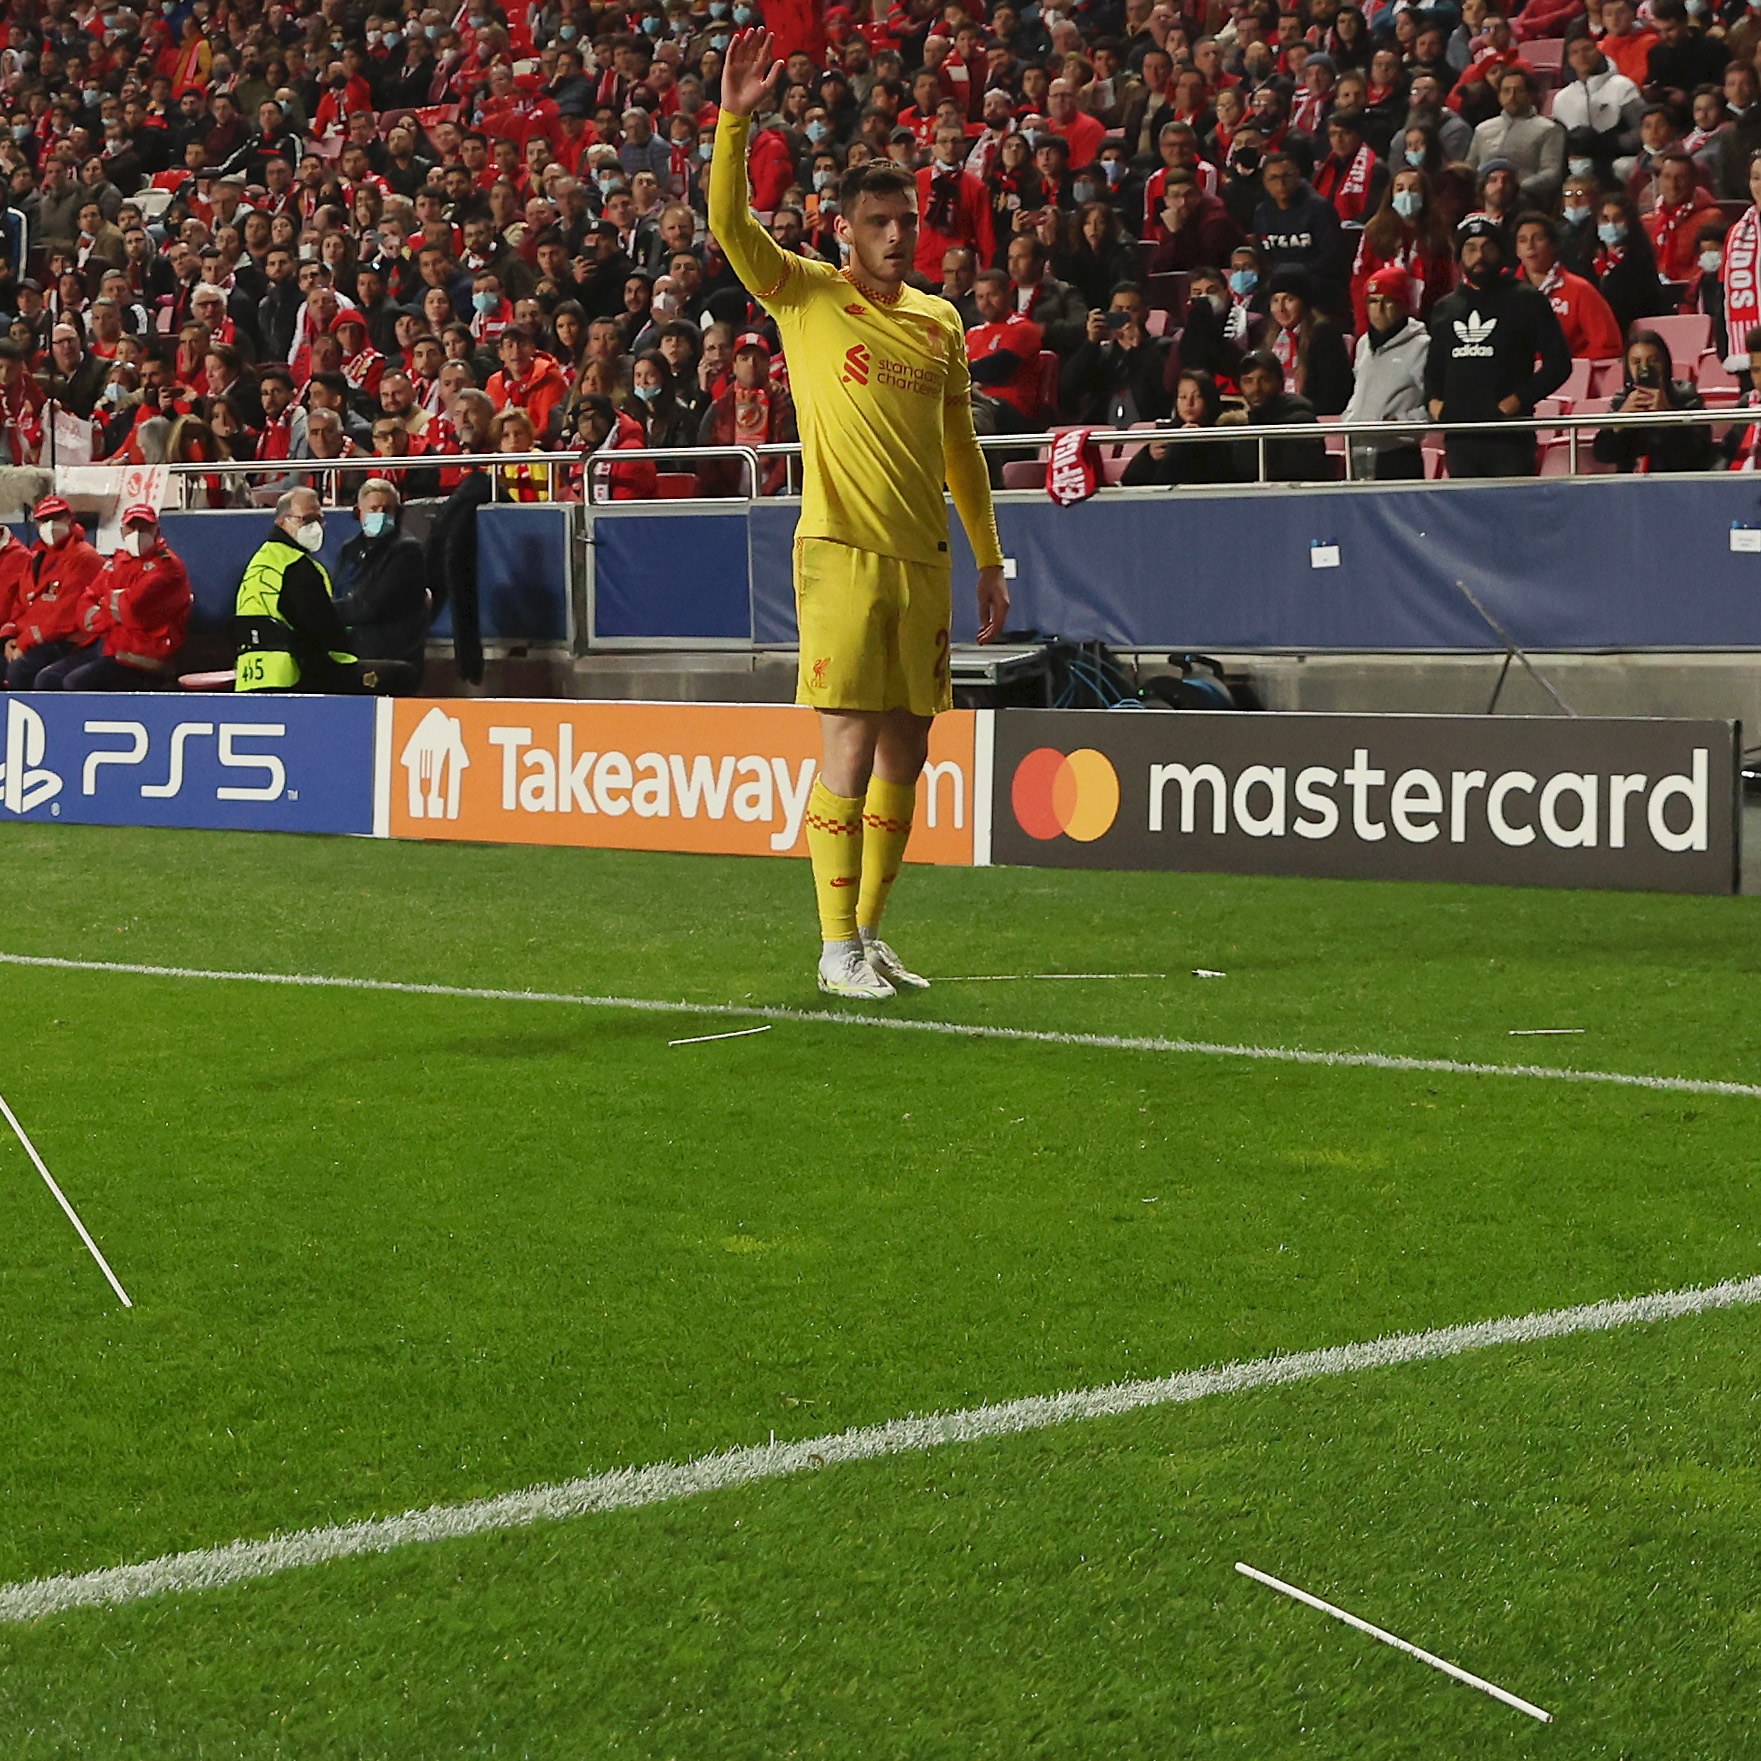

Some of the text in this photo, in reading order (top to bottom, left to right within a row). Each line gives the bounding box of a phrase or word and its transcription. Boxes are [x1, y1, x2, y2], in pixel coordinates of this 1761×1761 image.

[1452, 343, 1494, 358] adidas
[1051, 429, 1086, 506] ENFICA
[82, 720, 286, 801] PS5
[488, 722, 965, 852] Takeawaym
[1148, 748, 1709, 852] mastercard
